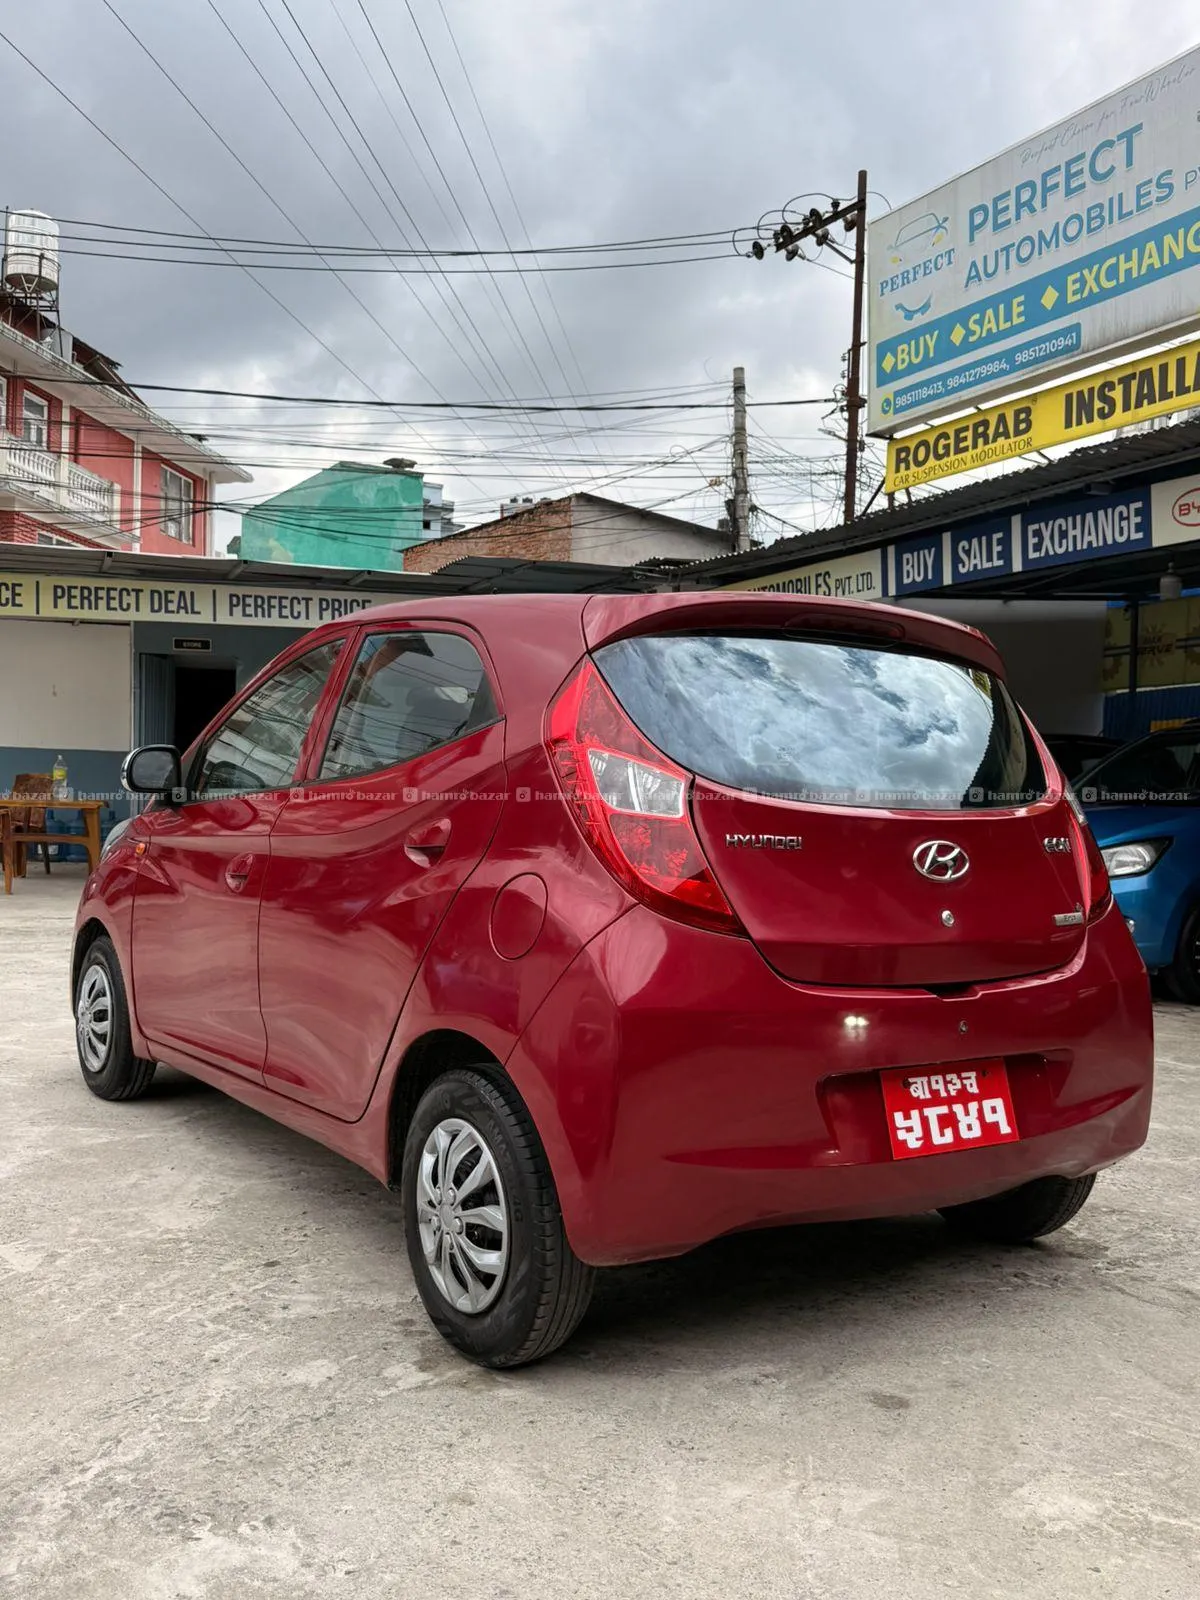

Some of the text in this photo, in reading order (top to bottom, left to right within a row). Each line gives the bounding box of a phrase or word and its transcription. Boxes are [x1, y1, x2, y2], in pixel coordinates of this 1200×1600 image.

[968, 122, 1143, 243] PERFECT
[964, 166, 1200, 288] AUTOMOBILES P
[879, 248, 955, 297] PERFECT
[896, 219, 1200, 370] BUY SALE EXCHANG
[895, 332, 1076, 408] 9851118413, 9841279984, 9851210941
[894, 436, 1033, 488] CAR SUSPENSION MODULATOR
[895, 406, 1032, 473] ROGERAB
[902, 501, 1144, 584] BUY SALE EXCHANGE
[53, 584, 144, 612] PERFECT
[150, 589, 201, 615] DEAL
[229, 593, 313, 620] PERFECT
[835, 576, 854, 597] PVT.
[856, 571, 875, 592] LTD.
[726, 834, 802, 849] HYUNDAI
[893, 1097, 1012, 1149] ५८४१
